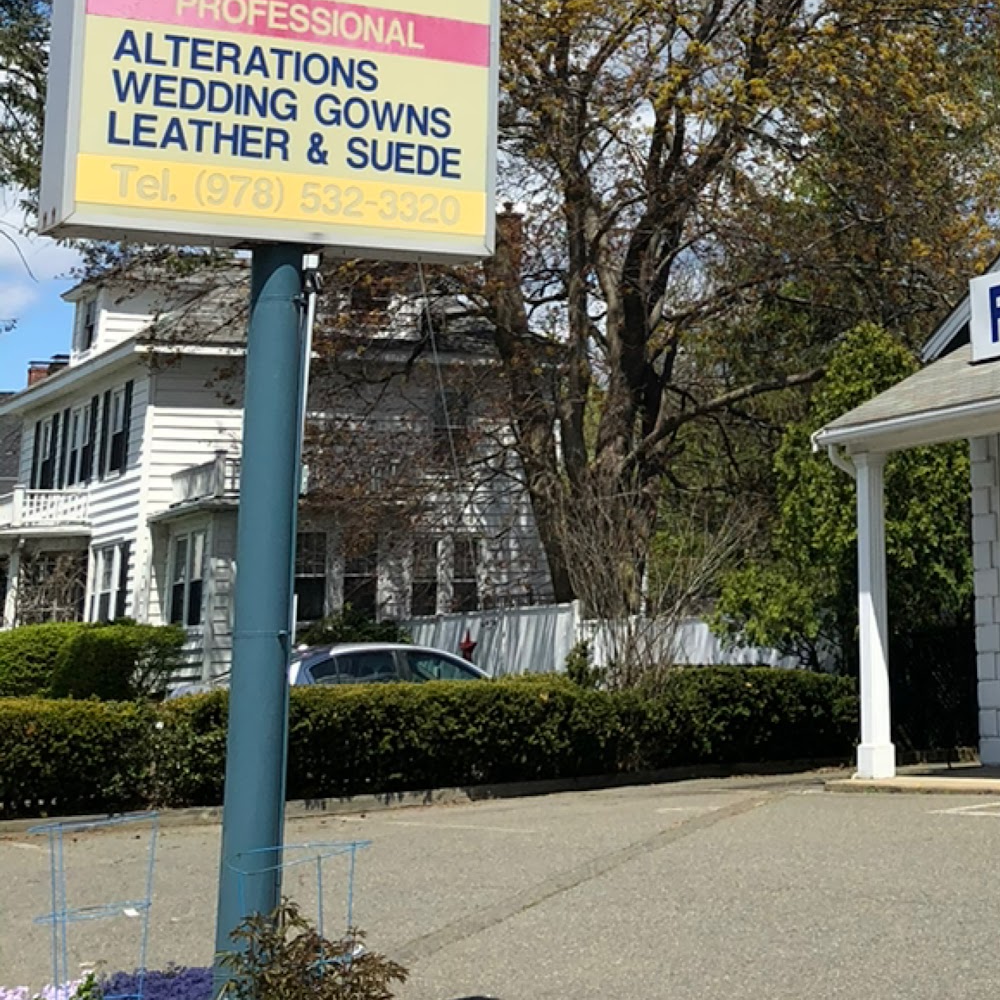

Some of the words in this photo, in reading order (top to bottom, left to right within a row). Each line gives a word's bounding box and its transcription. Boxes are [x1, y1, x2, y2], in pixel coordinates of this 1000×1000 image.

[113, 30, 379, 92] ALTERATIONS
[112, 69, 298, 122] WEDDING
[314, 93, 452, 139] GOWNS
[107, 110, 289, 161] LEATHER
[306, 133, 329, 166] &
[346, 137, 462, 180] SUEDE
[111, 163, 178, 202] Tel.
[194, 169, 285, 215] (978)
[299, 182, 462, 226] 532-3320
